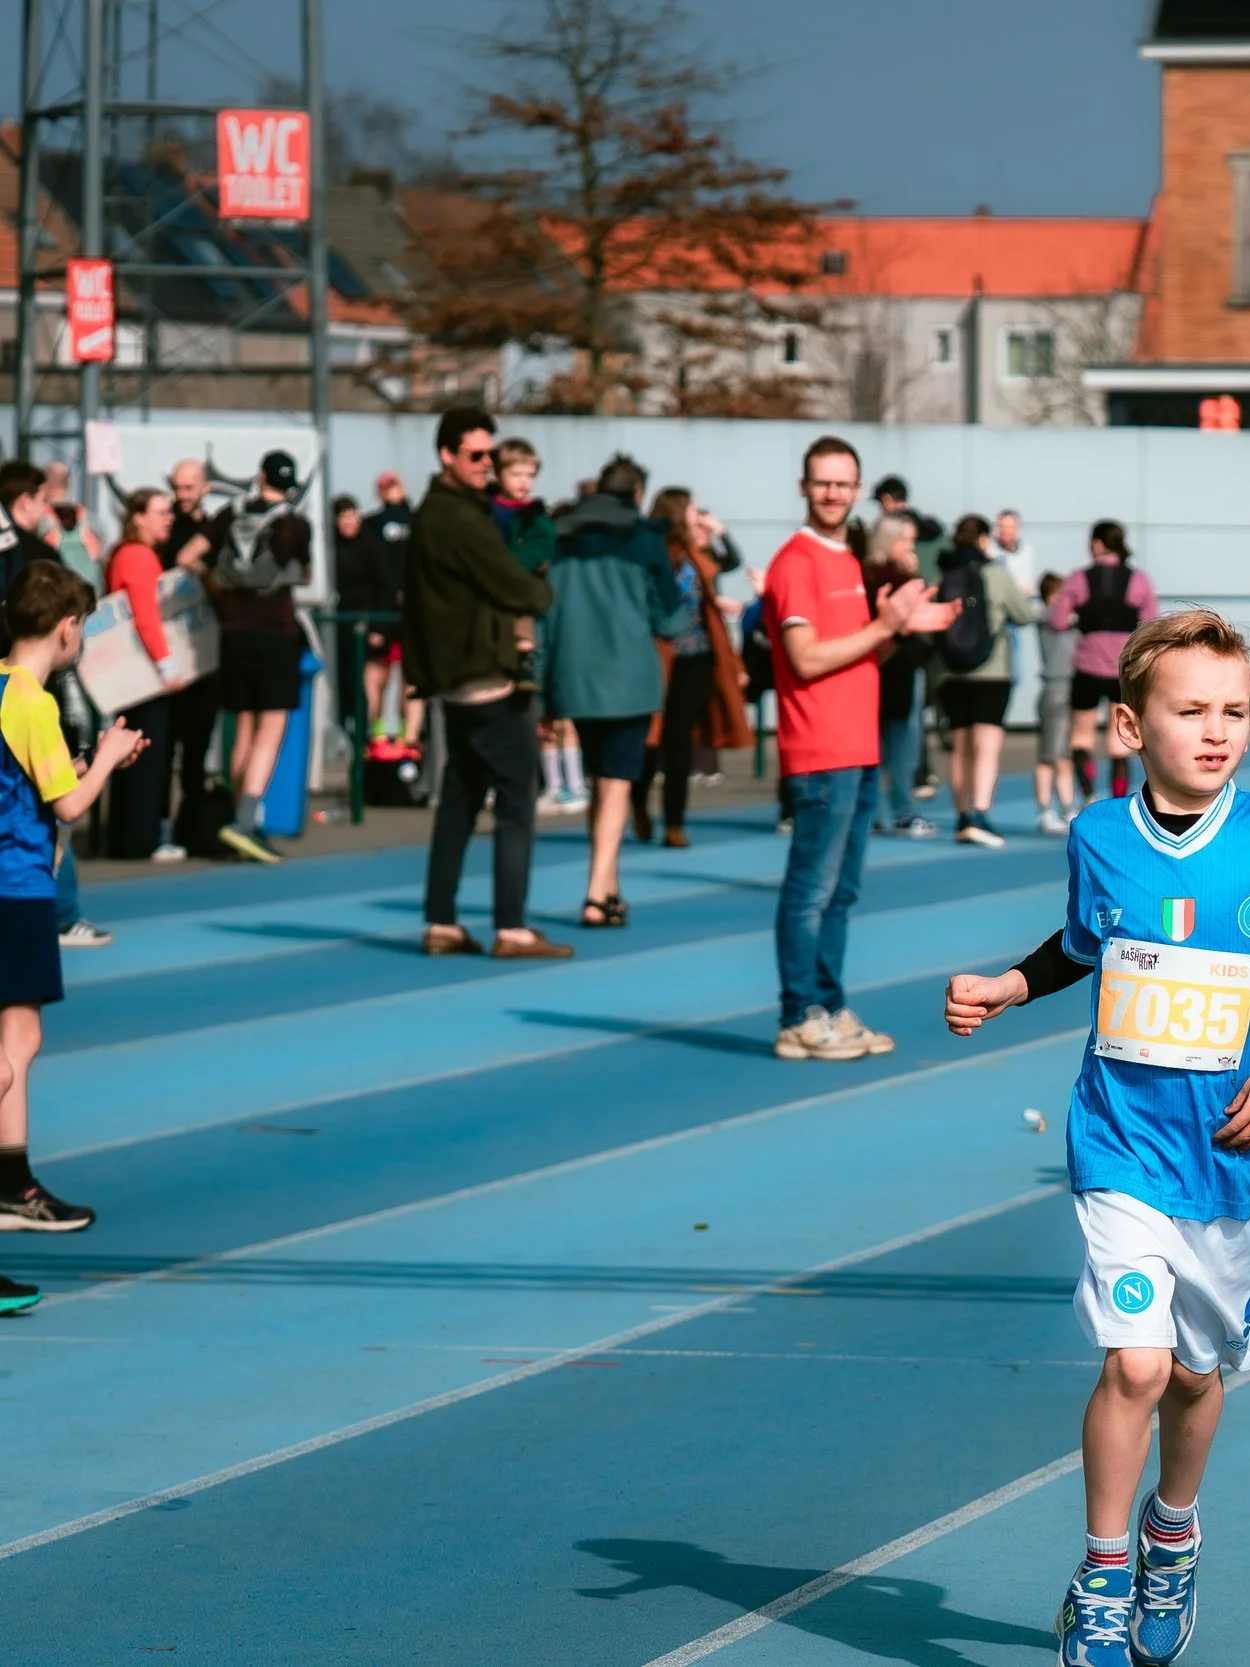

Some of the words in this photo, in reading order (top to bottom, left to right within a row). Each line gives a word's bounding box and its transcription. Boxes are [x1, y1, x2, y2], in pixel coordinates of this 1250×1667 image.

[223, 115, 302, 174] WC
[1120, 949, 1153, 962] BASHIR'S
[1209, 963, 1249, 978] KIDS
[1108, 979, 1240, 1044] 7035
[1122, 1281, 1143, 1305] N
